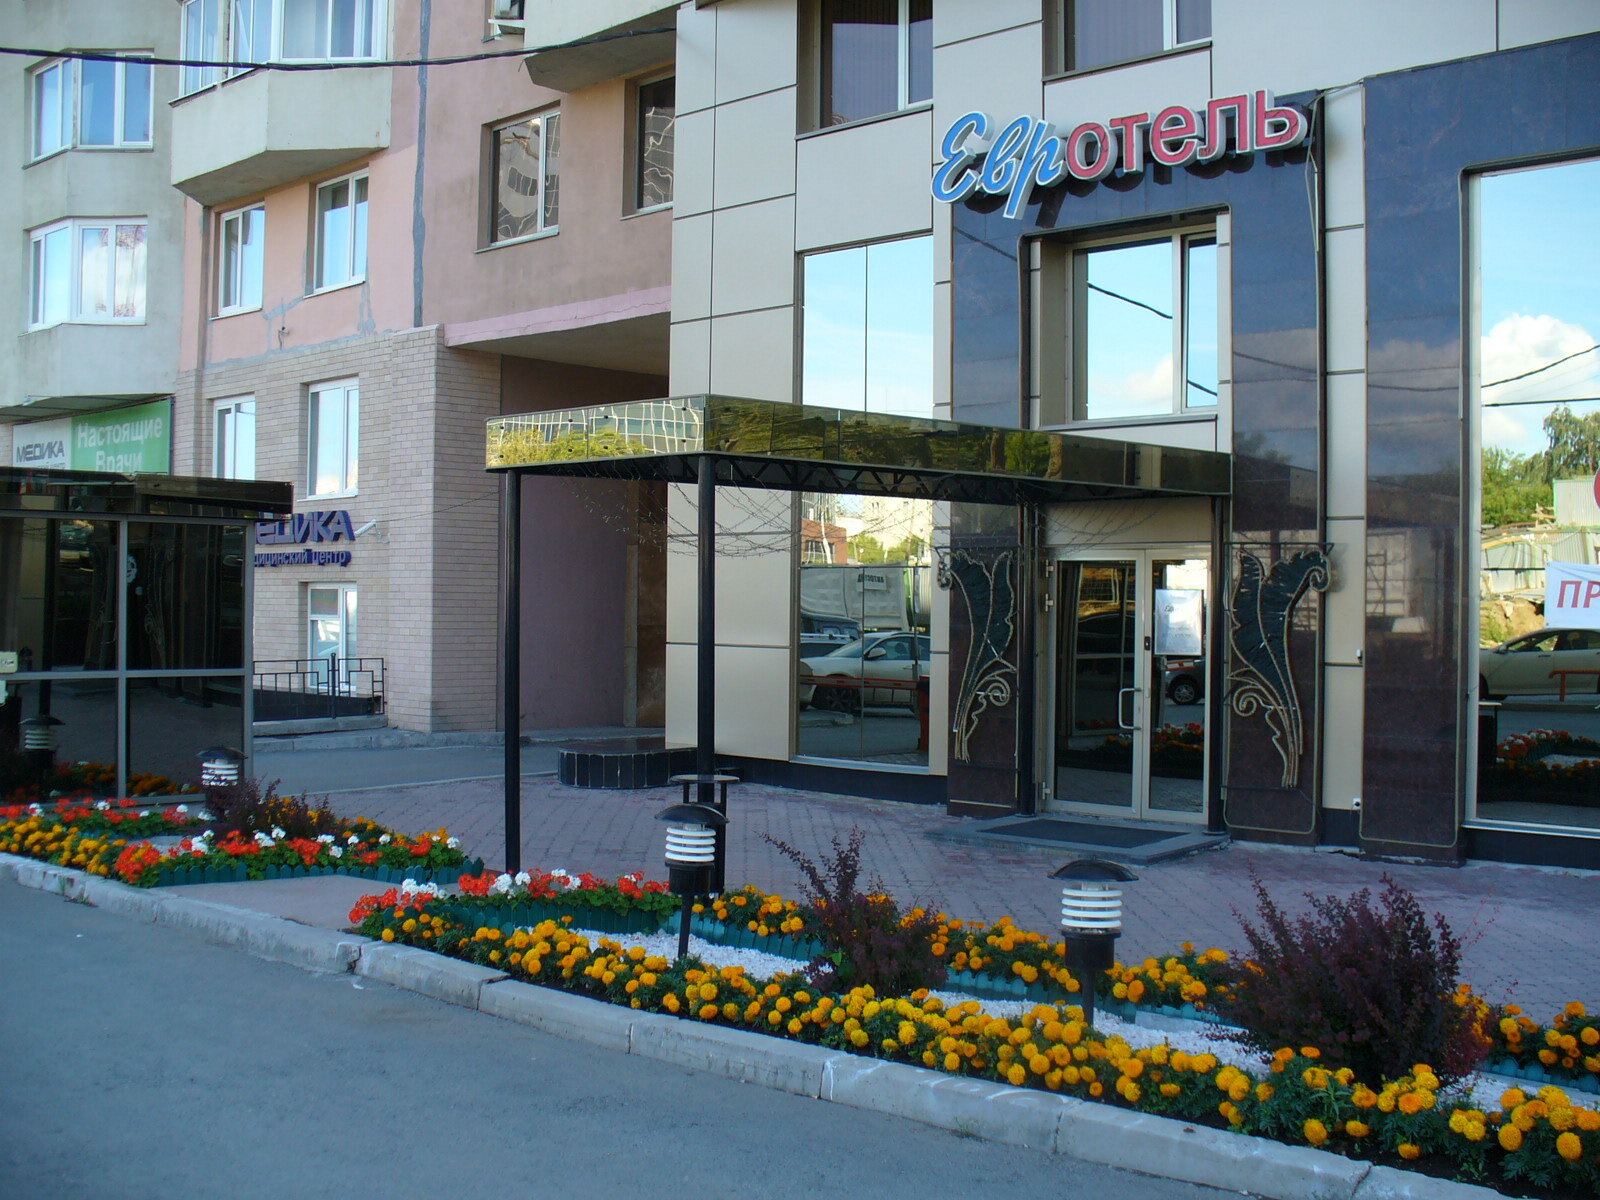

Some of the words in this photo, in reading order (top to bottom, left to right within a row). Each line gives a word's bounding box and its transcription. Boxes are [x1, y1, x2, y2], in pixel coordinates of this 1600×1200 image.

[931, 88, 1307, 220] Евротель
[77, 417, 163, 448] Настоящие
[16, 440, 65, 463] МЕДИКА
[96, 450, 142, 472] Врачи
[255, 509, 355, 545] ЕДИКА
[255, 548, 311, 567] дицинский
[312, 550, 352, 567] центр
